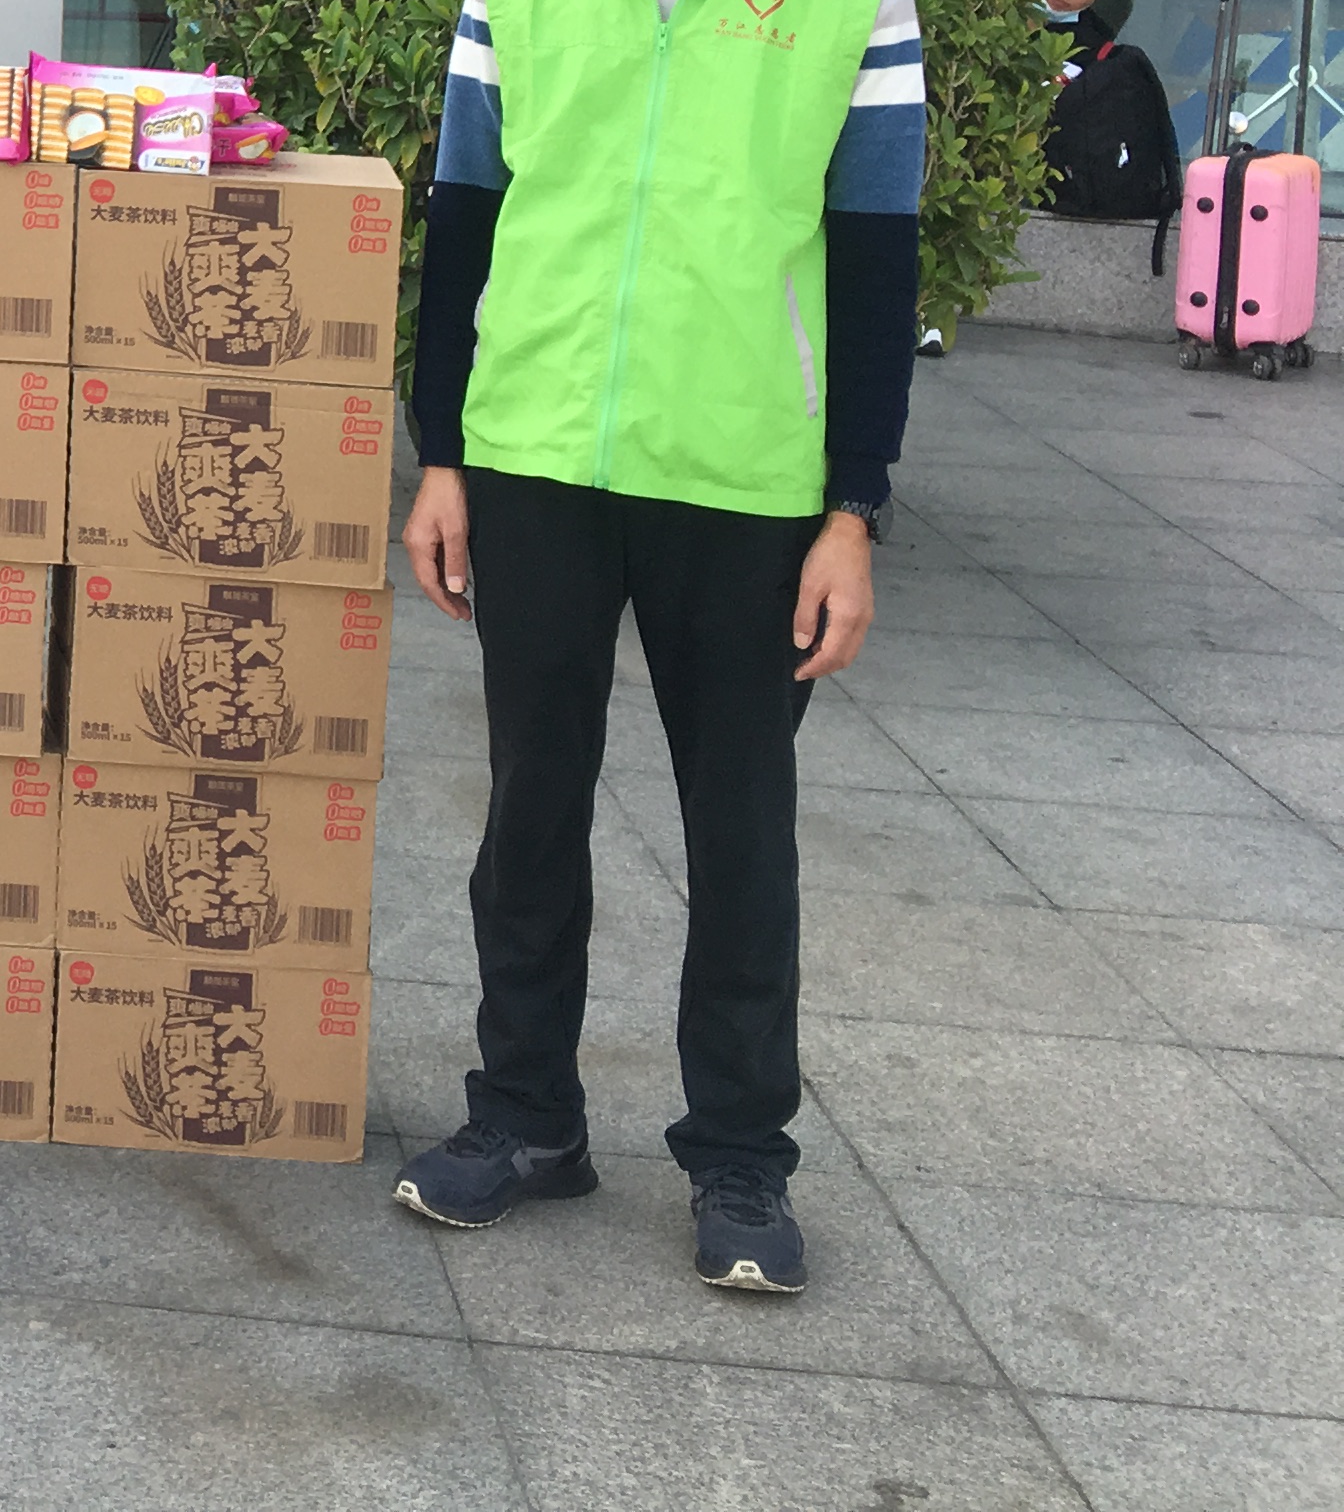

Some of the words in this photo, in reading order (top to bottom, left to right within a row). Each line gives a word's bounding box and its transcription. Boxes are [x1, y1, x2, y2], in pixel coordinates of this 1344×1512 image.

[143, 111, 205, 138] Cheese
[90, 204, 178, 226] 大麦茶饮料
[83, 406, 170, 427] 大麦茶饮料
[86, 601, 174, 623] 大麦茶饮料
[73, 790, 159, 811] 大麦茶饮料
[70, 986, 155, 1007] 大麦茶饮料
